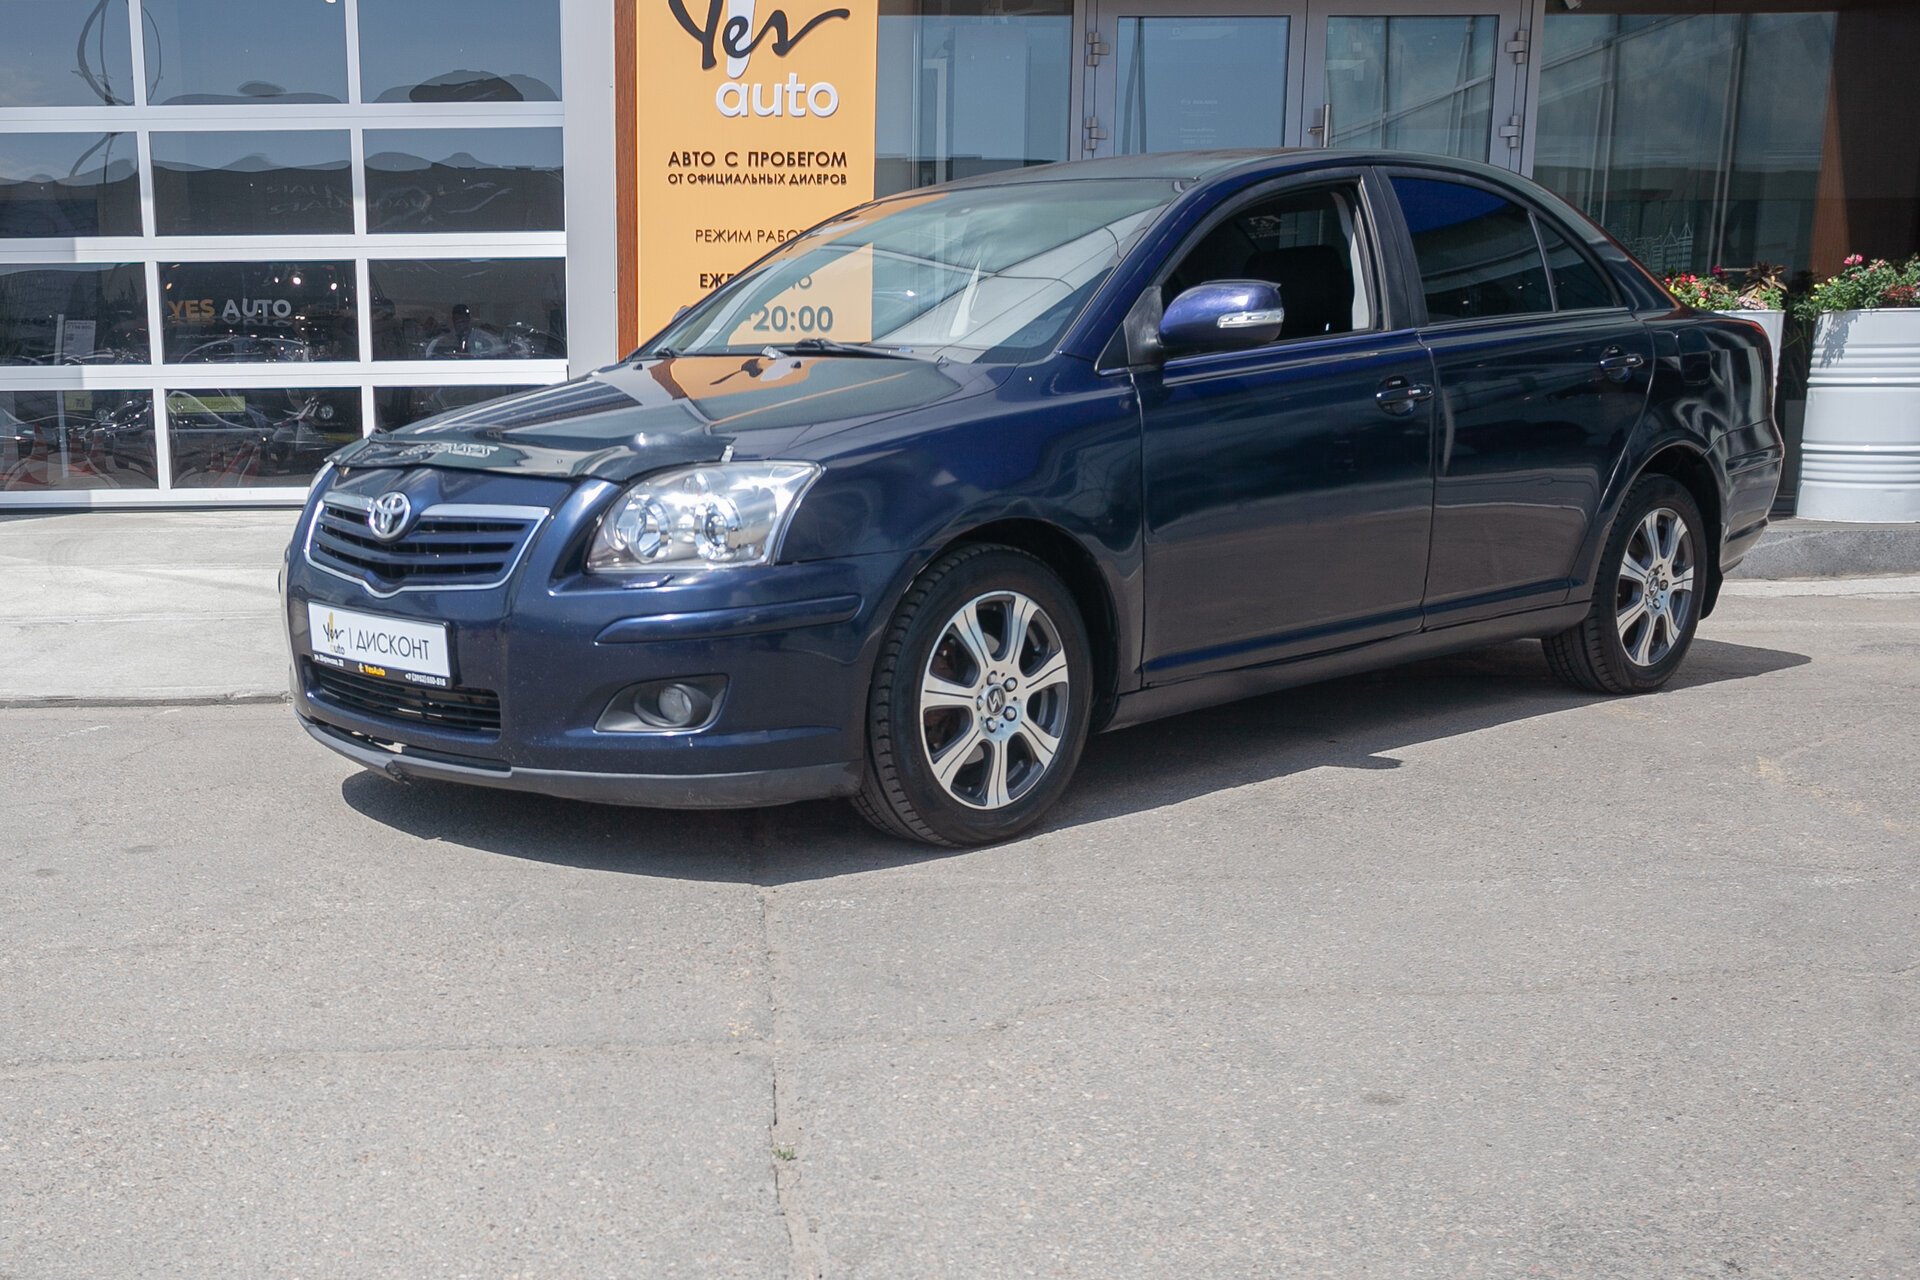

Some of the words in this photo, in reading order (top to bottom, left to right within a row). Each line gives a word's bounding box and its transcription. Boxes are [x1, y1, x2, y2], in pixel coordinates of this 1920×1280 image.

[715, 72, 839, 118] auto
[668, 151, 716, 168] АВТО
[724, 151, 739, 168] С
[748, 151, 848, 168] ПРОБЕГОМ
[668, 173, 684, 185] ОТ
[687, 172, 786, 185] ОФИЦИАЛЬНЫХ
[789, 173, 847, 186] ДИЛЕРОВ
[695, 229, 752, 243] РЕЖИМ
[757, 229, 805, 243] РАБО
[168, 300, 215, 318] YES
[222, 299, 292, 318] AUTO
[753, 306, 833, 332] 20:00
[356, 629, 429, 660] ДИСКОНТ
